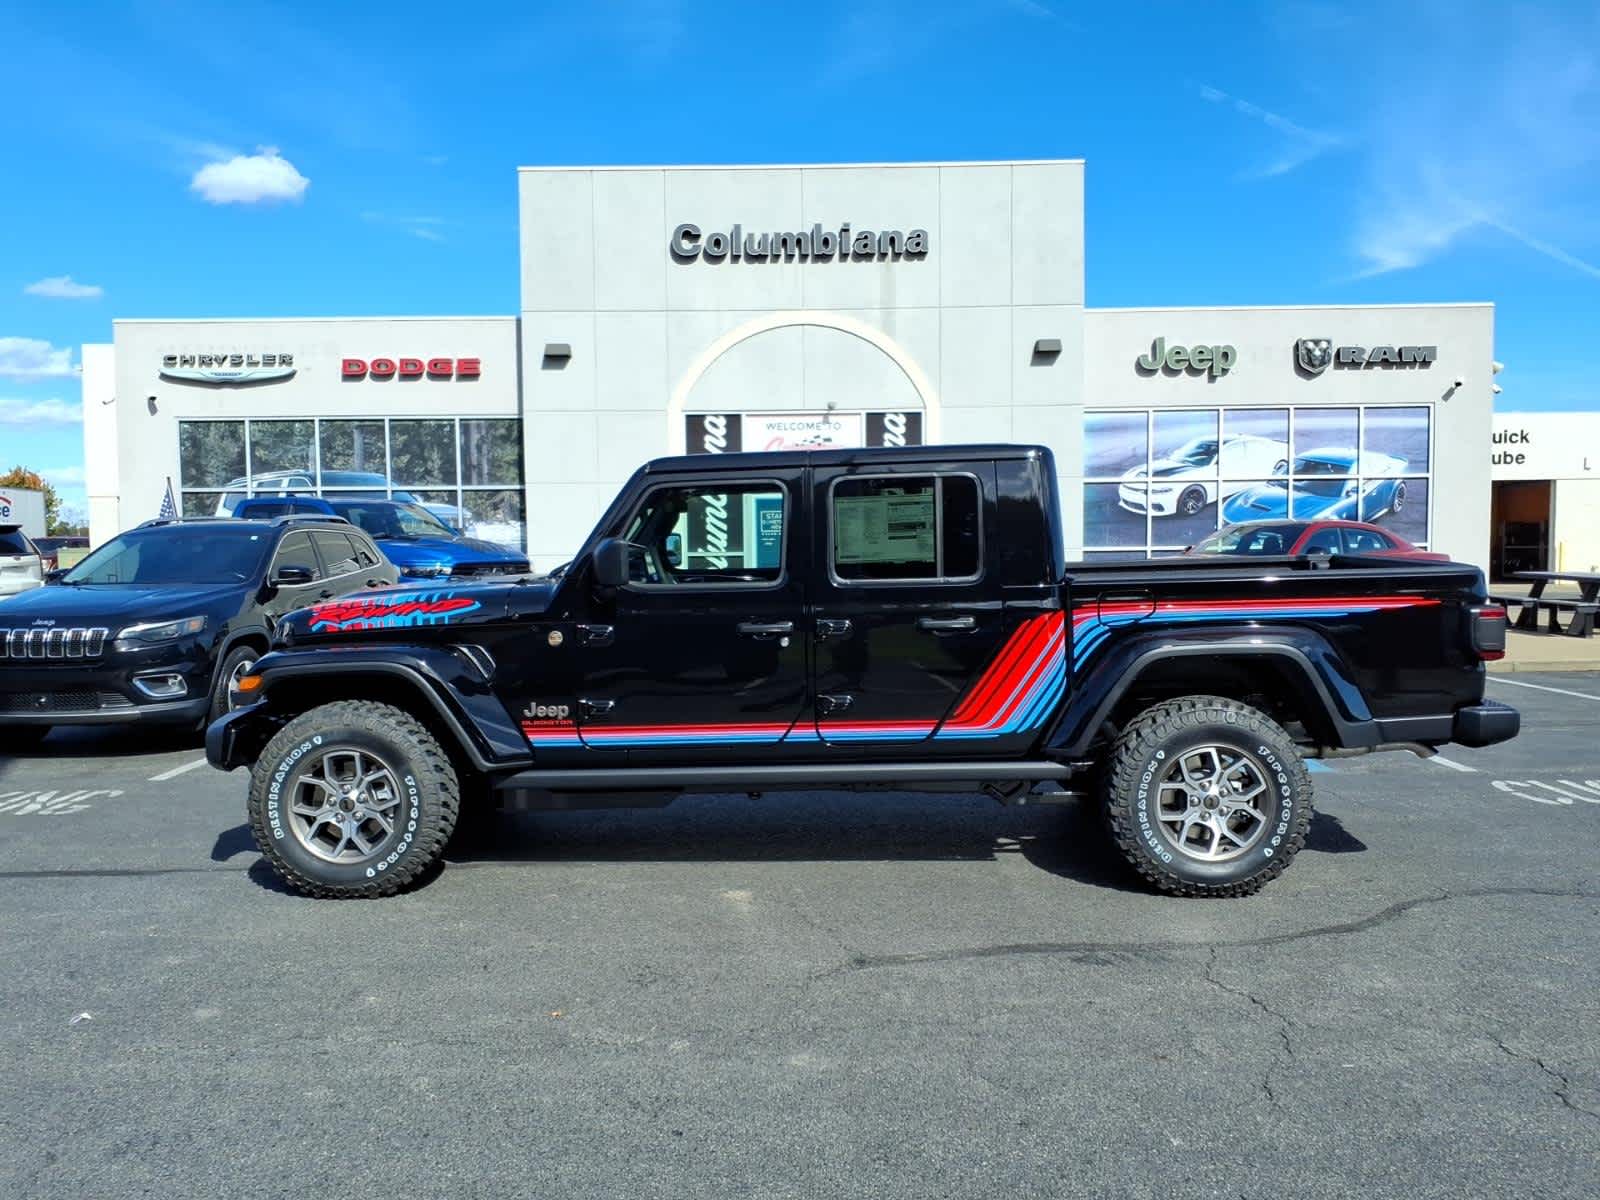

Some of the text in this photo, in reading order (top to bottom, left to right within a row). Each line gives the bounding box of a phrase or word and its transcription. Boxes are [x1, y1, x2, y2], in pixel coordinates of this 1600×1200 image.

[670, 222, 929, 263] Columbiana
[162, 353, 294, 368] CHRYSLER
[1136, 336, 1238, 380] Jeep
[1335, 345, 1438, 368] RAM
[341, 357, 481, 380] DODGE
[765, 421, 842, 432] WELCOME TO
[31, 618, 56, 627] Jeep
[522, 701, 570, 720] Jeep
[267, 740, 313, 841] DESTINATION
[1137, 759, 1174, 865] DESTINATION
